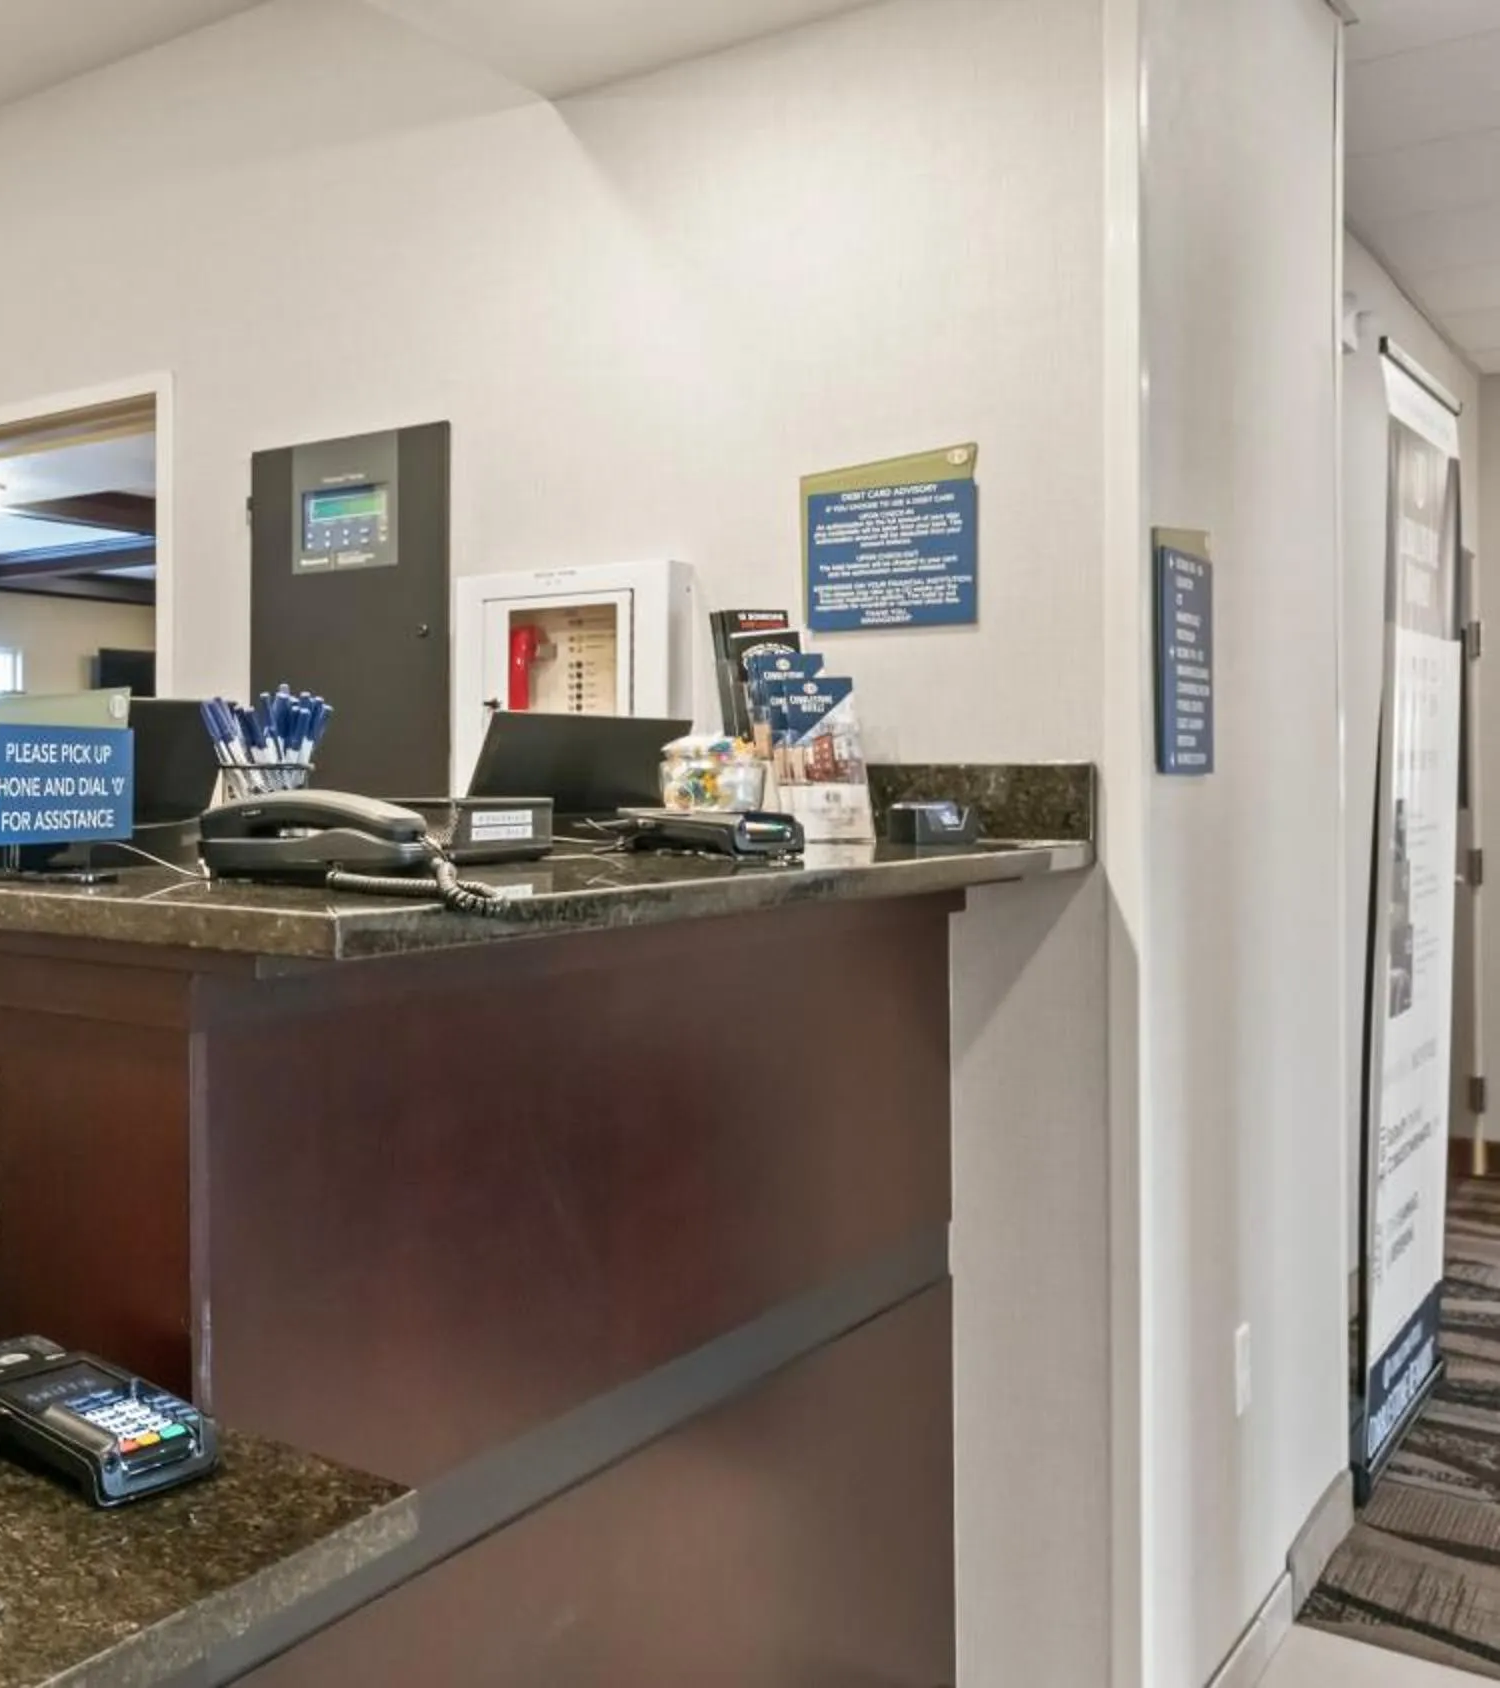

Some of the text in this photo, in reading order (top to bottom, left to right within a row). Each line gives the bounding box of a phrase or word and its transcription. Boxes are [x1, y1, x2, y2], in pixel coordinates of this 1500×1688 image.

[5, 743, 112, 764] PLEASE PICK UP
[43, 777, 75, 797] AND
[78, 777, 108, 797] DIAL
[1, 809, 115, 832] FOR ASSISTANCE
